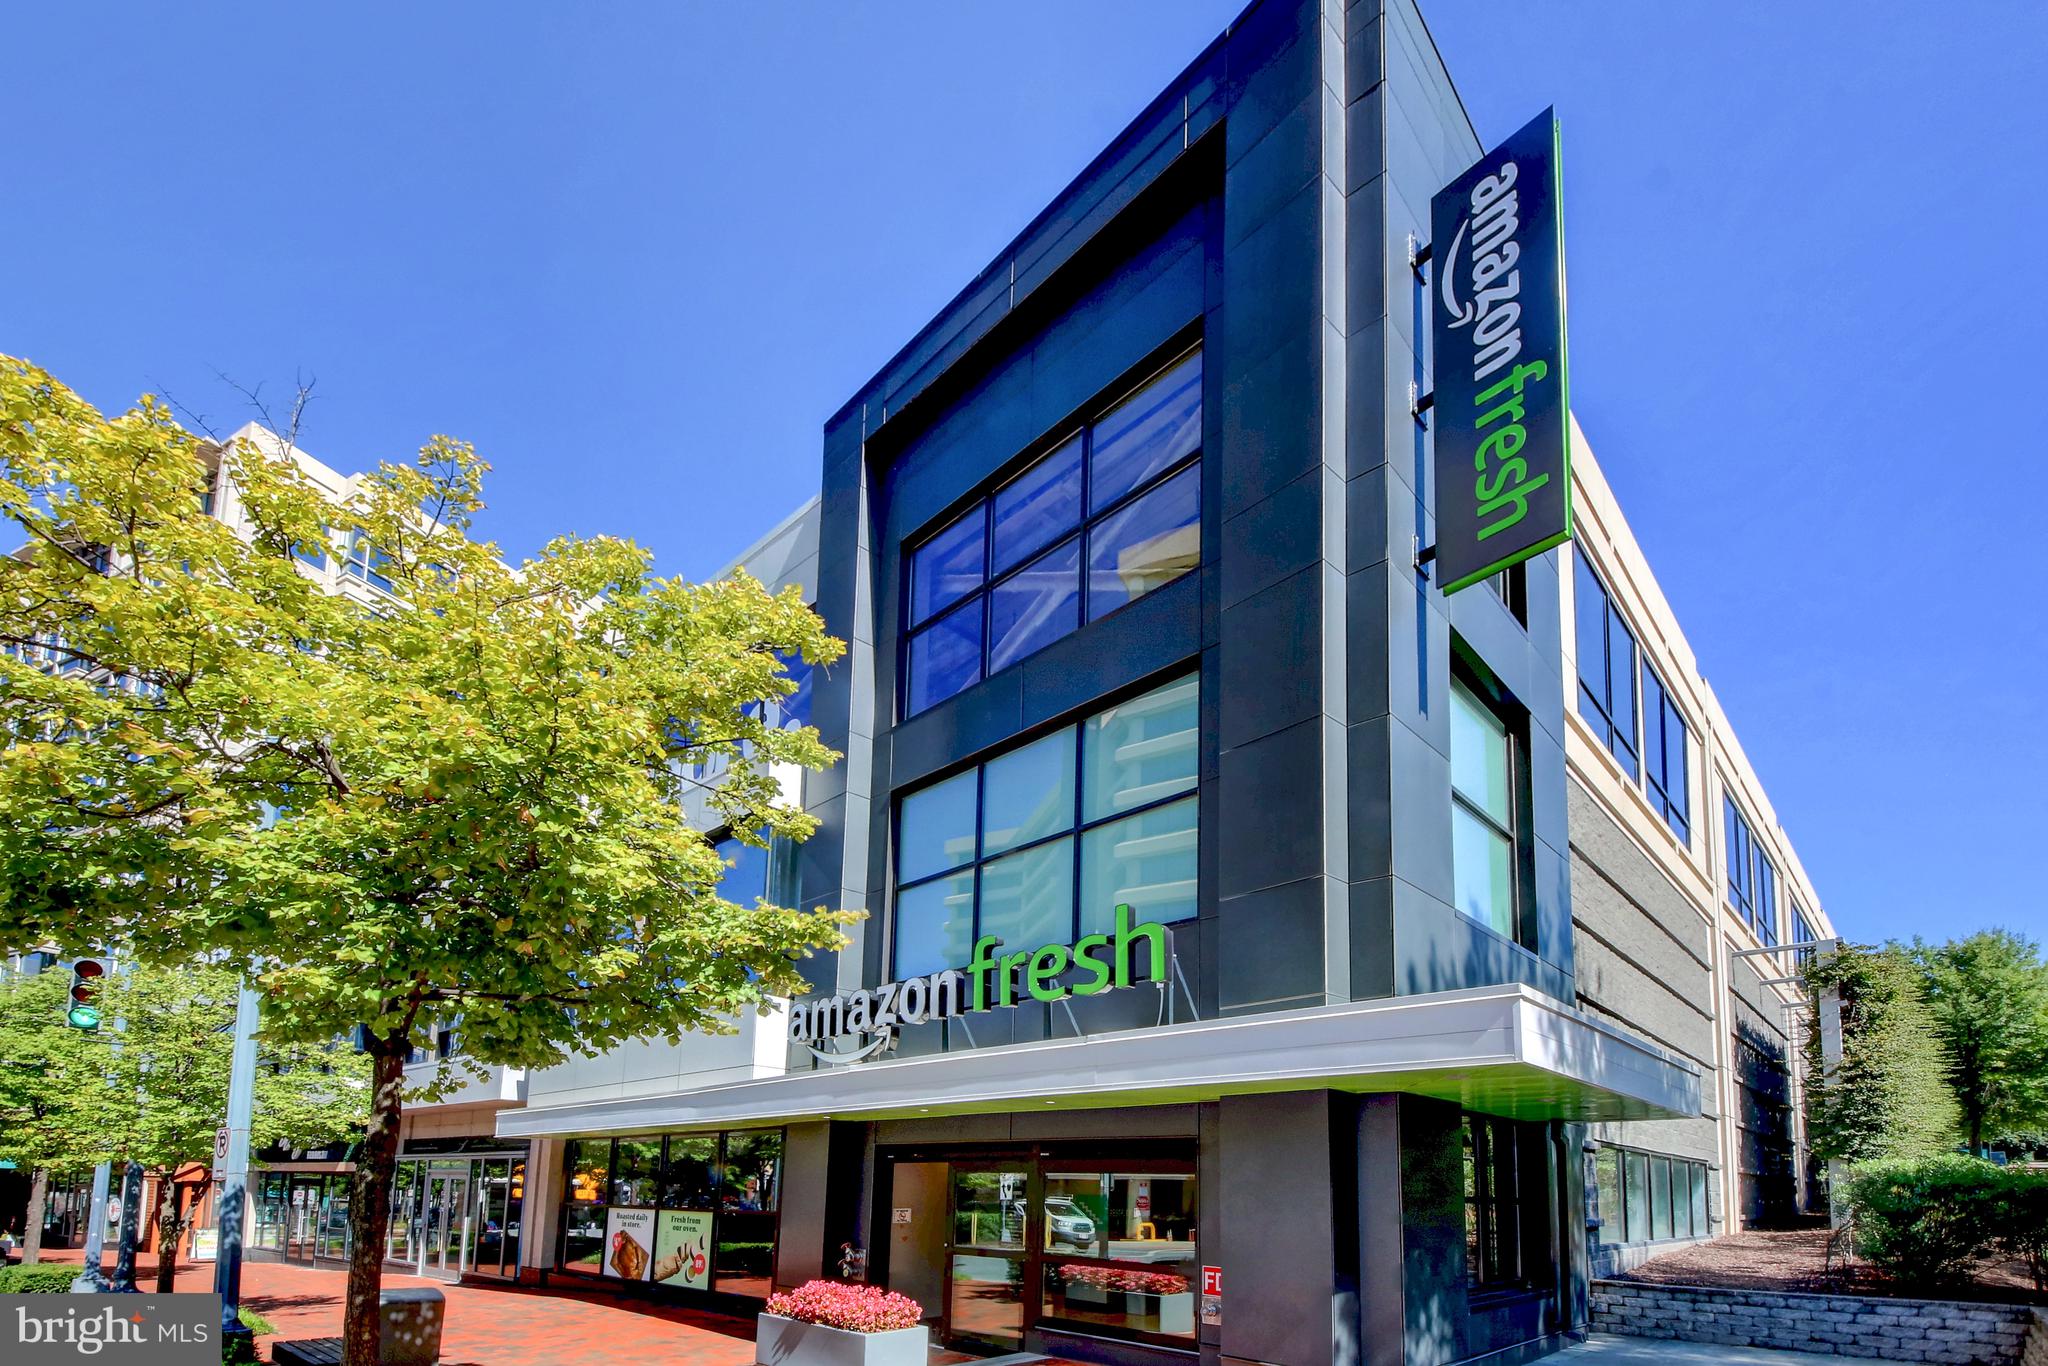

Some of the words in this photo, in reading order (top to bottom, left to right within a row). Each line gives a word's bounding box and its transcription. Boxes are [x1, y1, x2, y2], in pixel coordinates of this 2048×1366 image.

[1471, 161, 1522, 383] amazon
[1475, 359, 1550, 542] fresh
[787, 967, 966, 1045] amazon
[966, 903, 1174, 1014] fresh
[616, 1213, 635, 1221] Roasted
[636, 1213, 648, 1221] daily
[671, 1215, 686, 1224] Fresh
[686, 1216, 701, 1225] from
